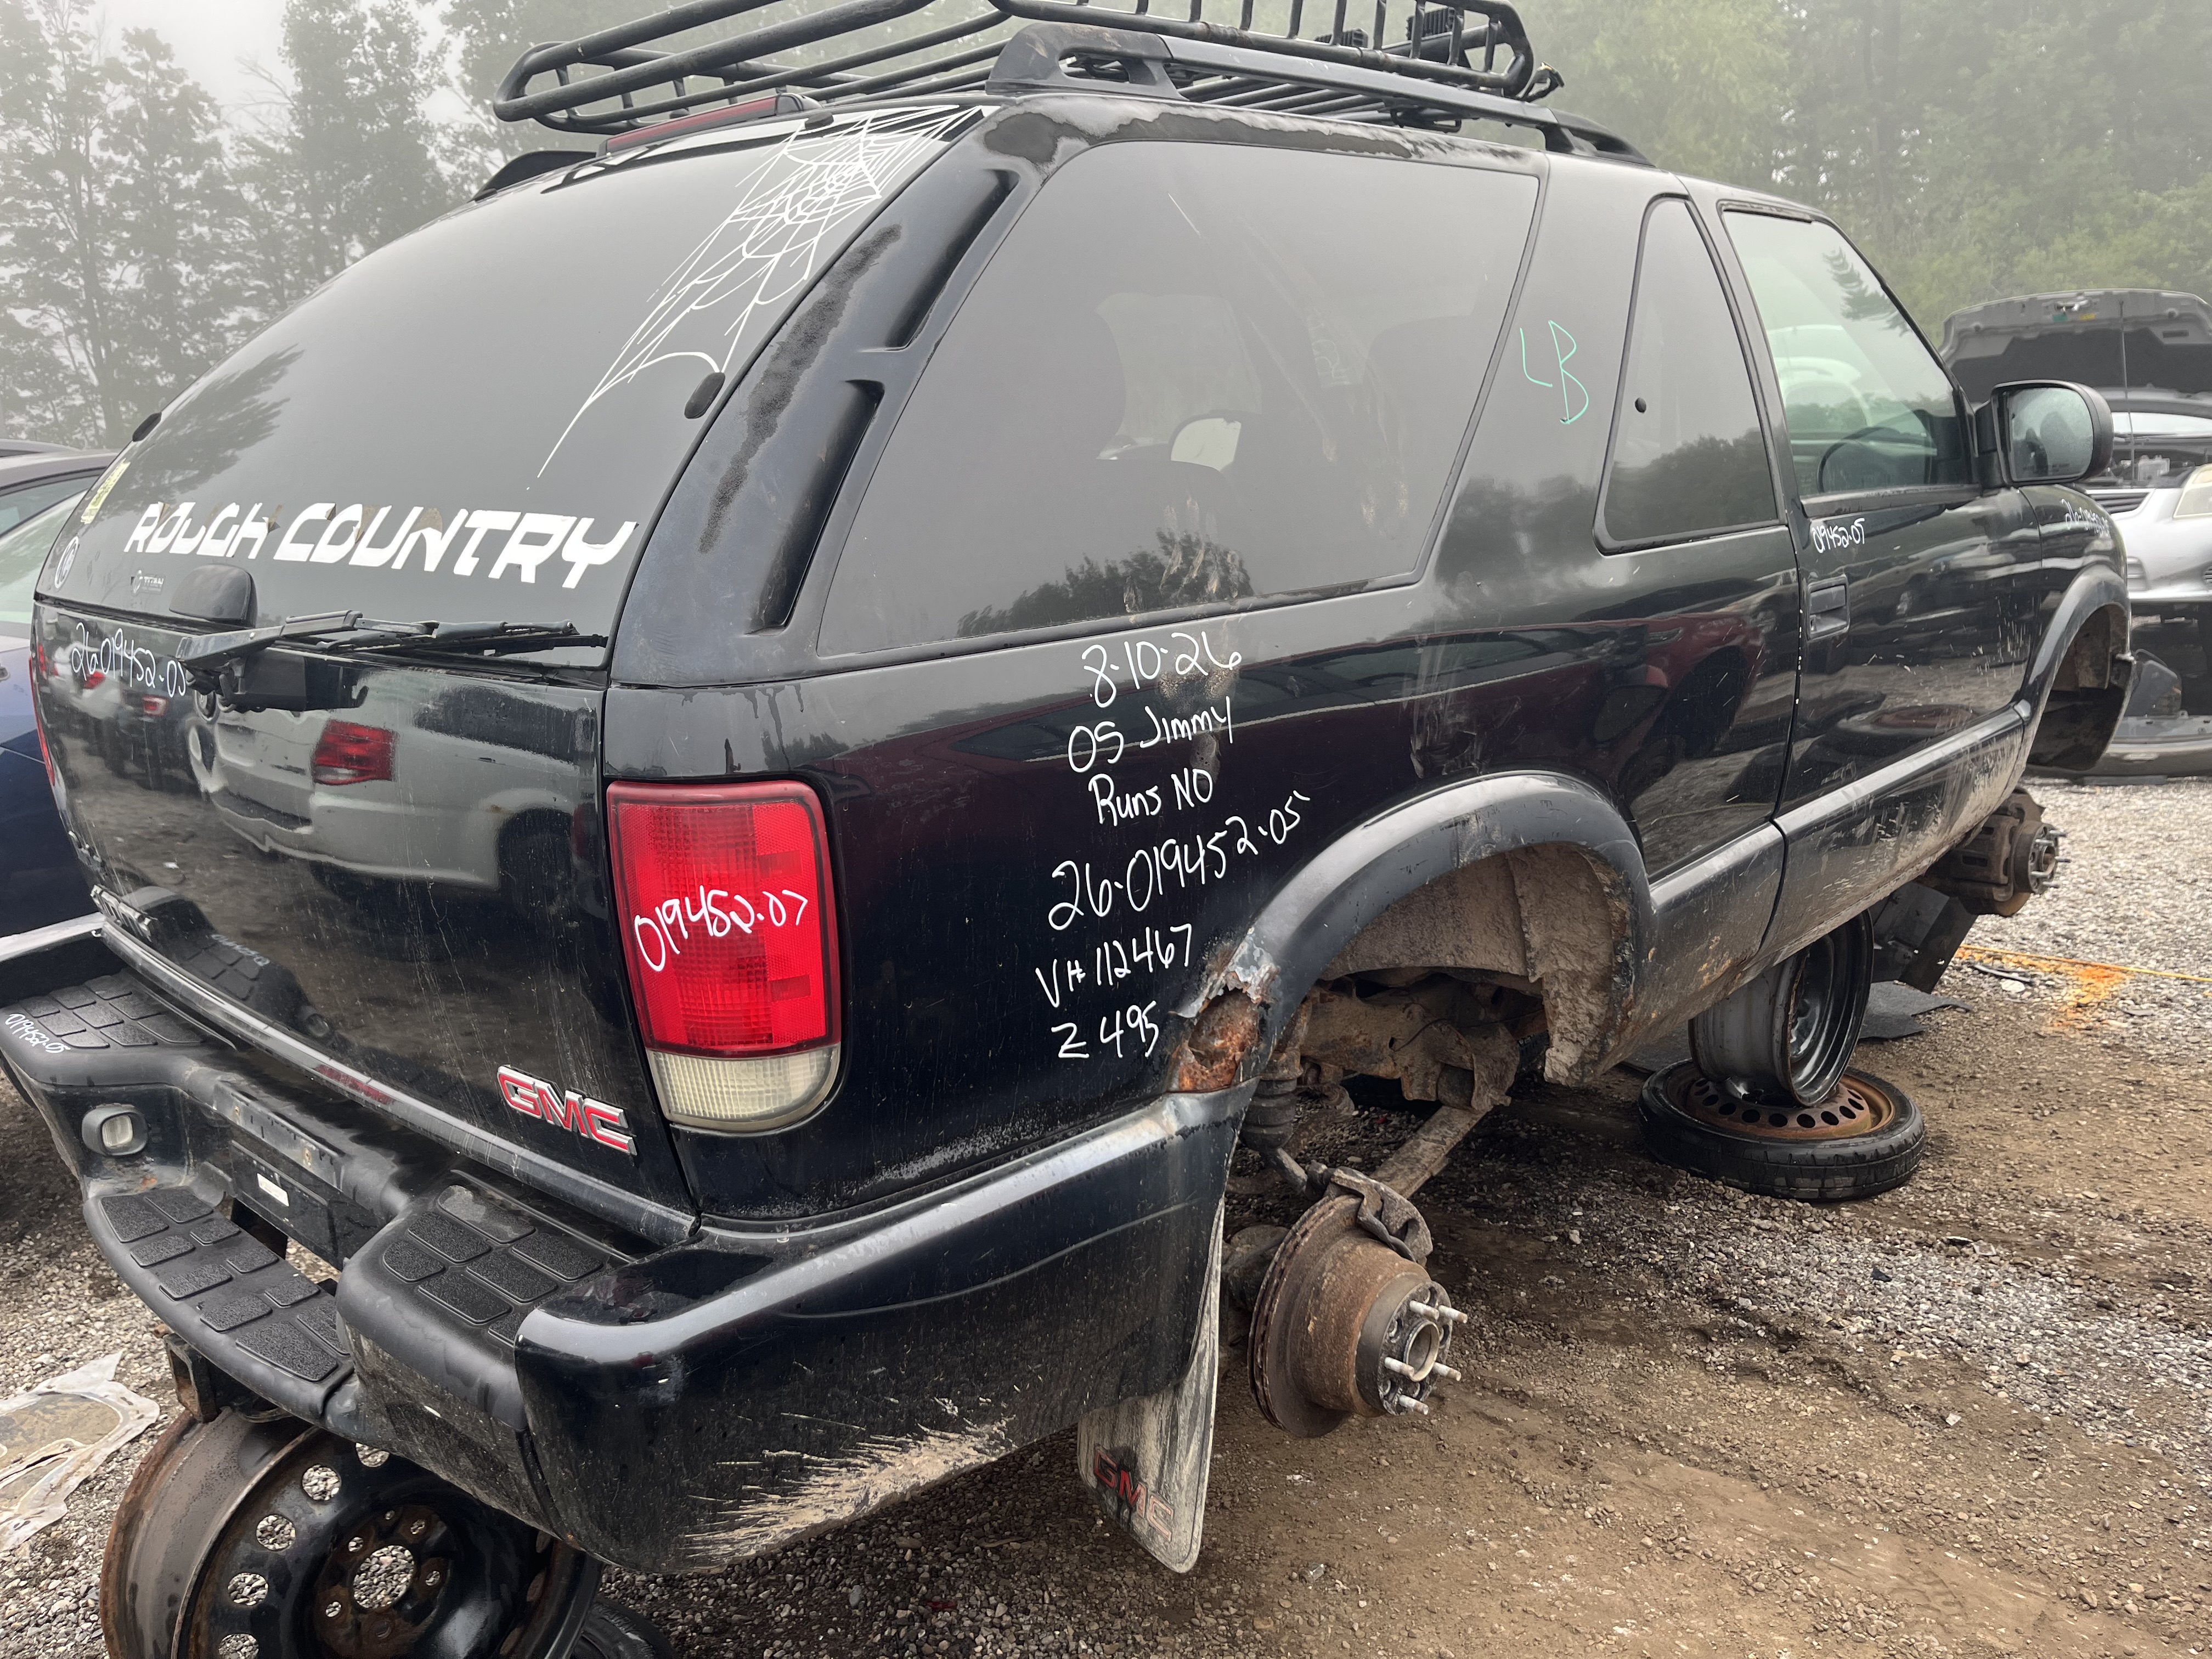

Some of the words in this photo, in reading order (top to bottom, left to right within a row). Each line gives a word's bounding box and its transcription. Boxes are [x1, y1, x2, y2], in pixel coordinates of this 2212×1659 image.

[125, 501, 276, 560] ROUGH
[274, 503, 639, 589] COUNTRY
[1088, 773, 1162, 827] Runs
[1171, 768, 1213, 810] NO
[1099, 1000, 1159, 1058] 495
[497, 1064, 637, 1155] GMC
[1094, 1444, 1174, 1543] GMC
